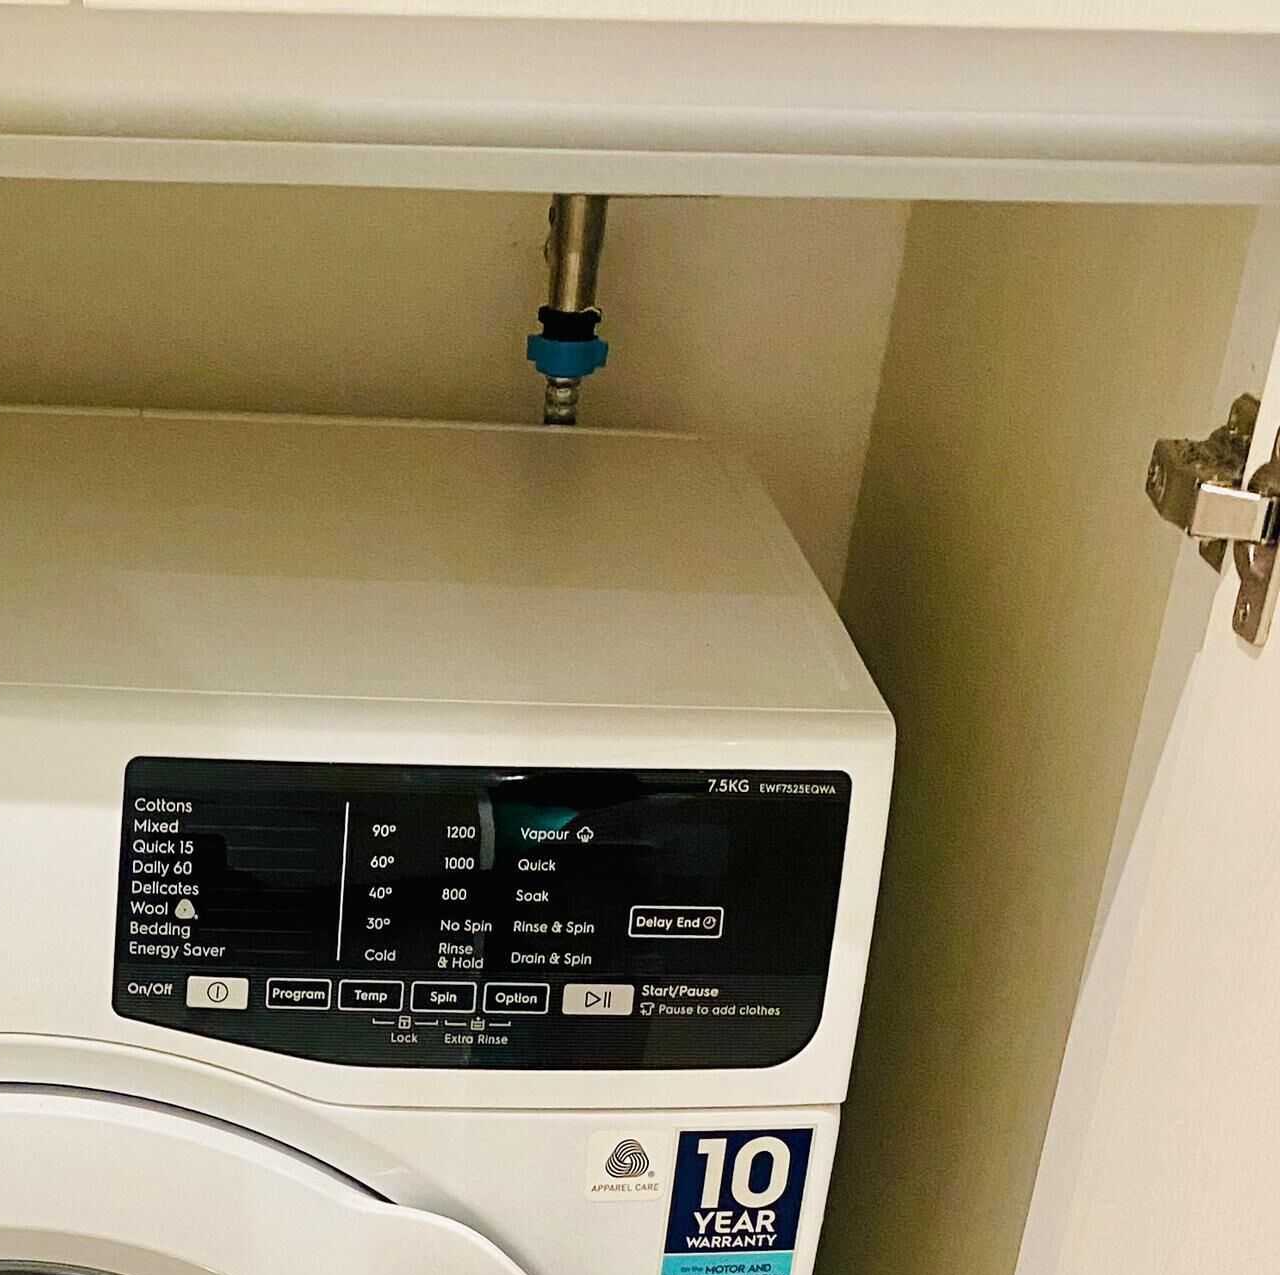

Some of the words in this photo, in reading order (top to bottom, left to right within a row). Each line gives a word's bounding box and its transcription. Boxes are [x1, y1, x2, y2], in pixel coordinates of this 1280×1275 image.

[708, 779, 750, 793] 7.5KG
[759, 783, 837, 795] EWF7525EQWA
[134, 797, 193, 813] Cottons
[133, 819, 179, 833] Mixed
[447, 825, 476, 839] 1200
[520, 827, 570, 842] Vapour
[132, 839, 175, 854] Quick
[179, 840, 194, 854] 15
[132, 860, 169, 877] Daily
[173, 861, 192, 875] 60
[444, 857, 475, 870] 1000
[517, 859, 556, 872] Quick
[131, 880, 199, 896] Delicates
[442, 888, 467, 900] 800
[516, 889, 549, 902] Soak
[130, 901, 169, 915] Wool
[130, 921, 191, 939] Bedding
[440, 920, 460, 932] No
[464, 920, 493, 934] Spin
[513, 921, 548, 933] Rinse
[551, 921, 562, 933] &
[565, 921, 595, 936] Spin
[636, 916, 673, 930] Delay
[677, 917, 700, 928] End
[129, 942, 179, 959] Energy
[183, 942, 226, 957] Saver
[364, 949, 397, 962] Cold
[438, 943, 474, 955] Rinse
[437, 956, 448, 968] &
[452, 957, 484, 969] Hold
[511, 952, 545, 965] Drain
[549, 952, 560, 965] &
[563, 953, 592, 967] Spin
[127, 982, 173, 997] On/Off
[272, 987, 326, 1002] Program
[354, 989, 388, 1003] Temp
[641, 984, 719, 998] Start/Pause
[430, 991, 458, 1005] Spin
[495, 992, 538, 1006] Option
[658, 1004, 693, 1015] Pause
[696, 1005, 709, 1015] to
[712, 1005, 736, 1016] add
[739, 1005, 781, 1016] clothes
[390, 1032, 418, 1044] Lock
[444, 1034, 474, 1045] Extra
[477, 1034, 508, 1045] Rinse
[697, 1135, 791, 1209] 10
[591, 1183, 633, 1193] APPAREL
[635, 1182, 659, 1192] CARE
[693, 1209, 776, 1235] YEAR
[686, 1234, 778, 1249] WARRANTY
[705, 1263, 746, 1274] MOTOR
[748, 1263, 772, 1272] AND
